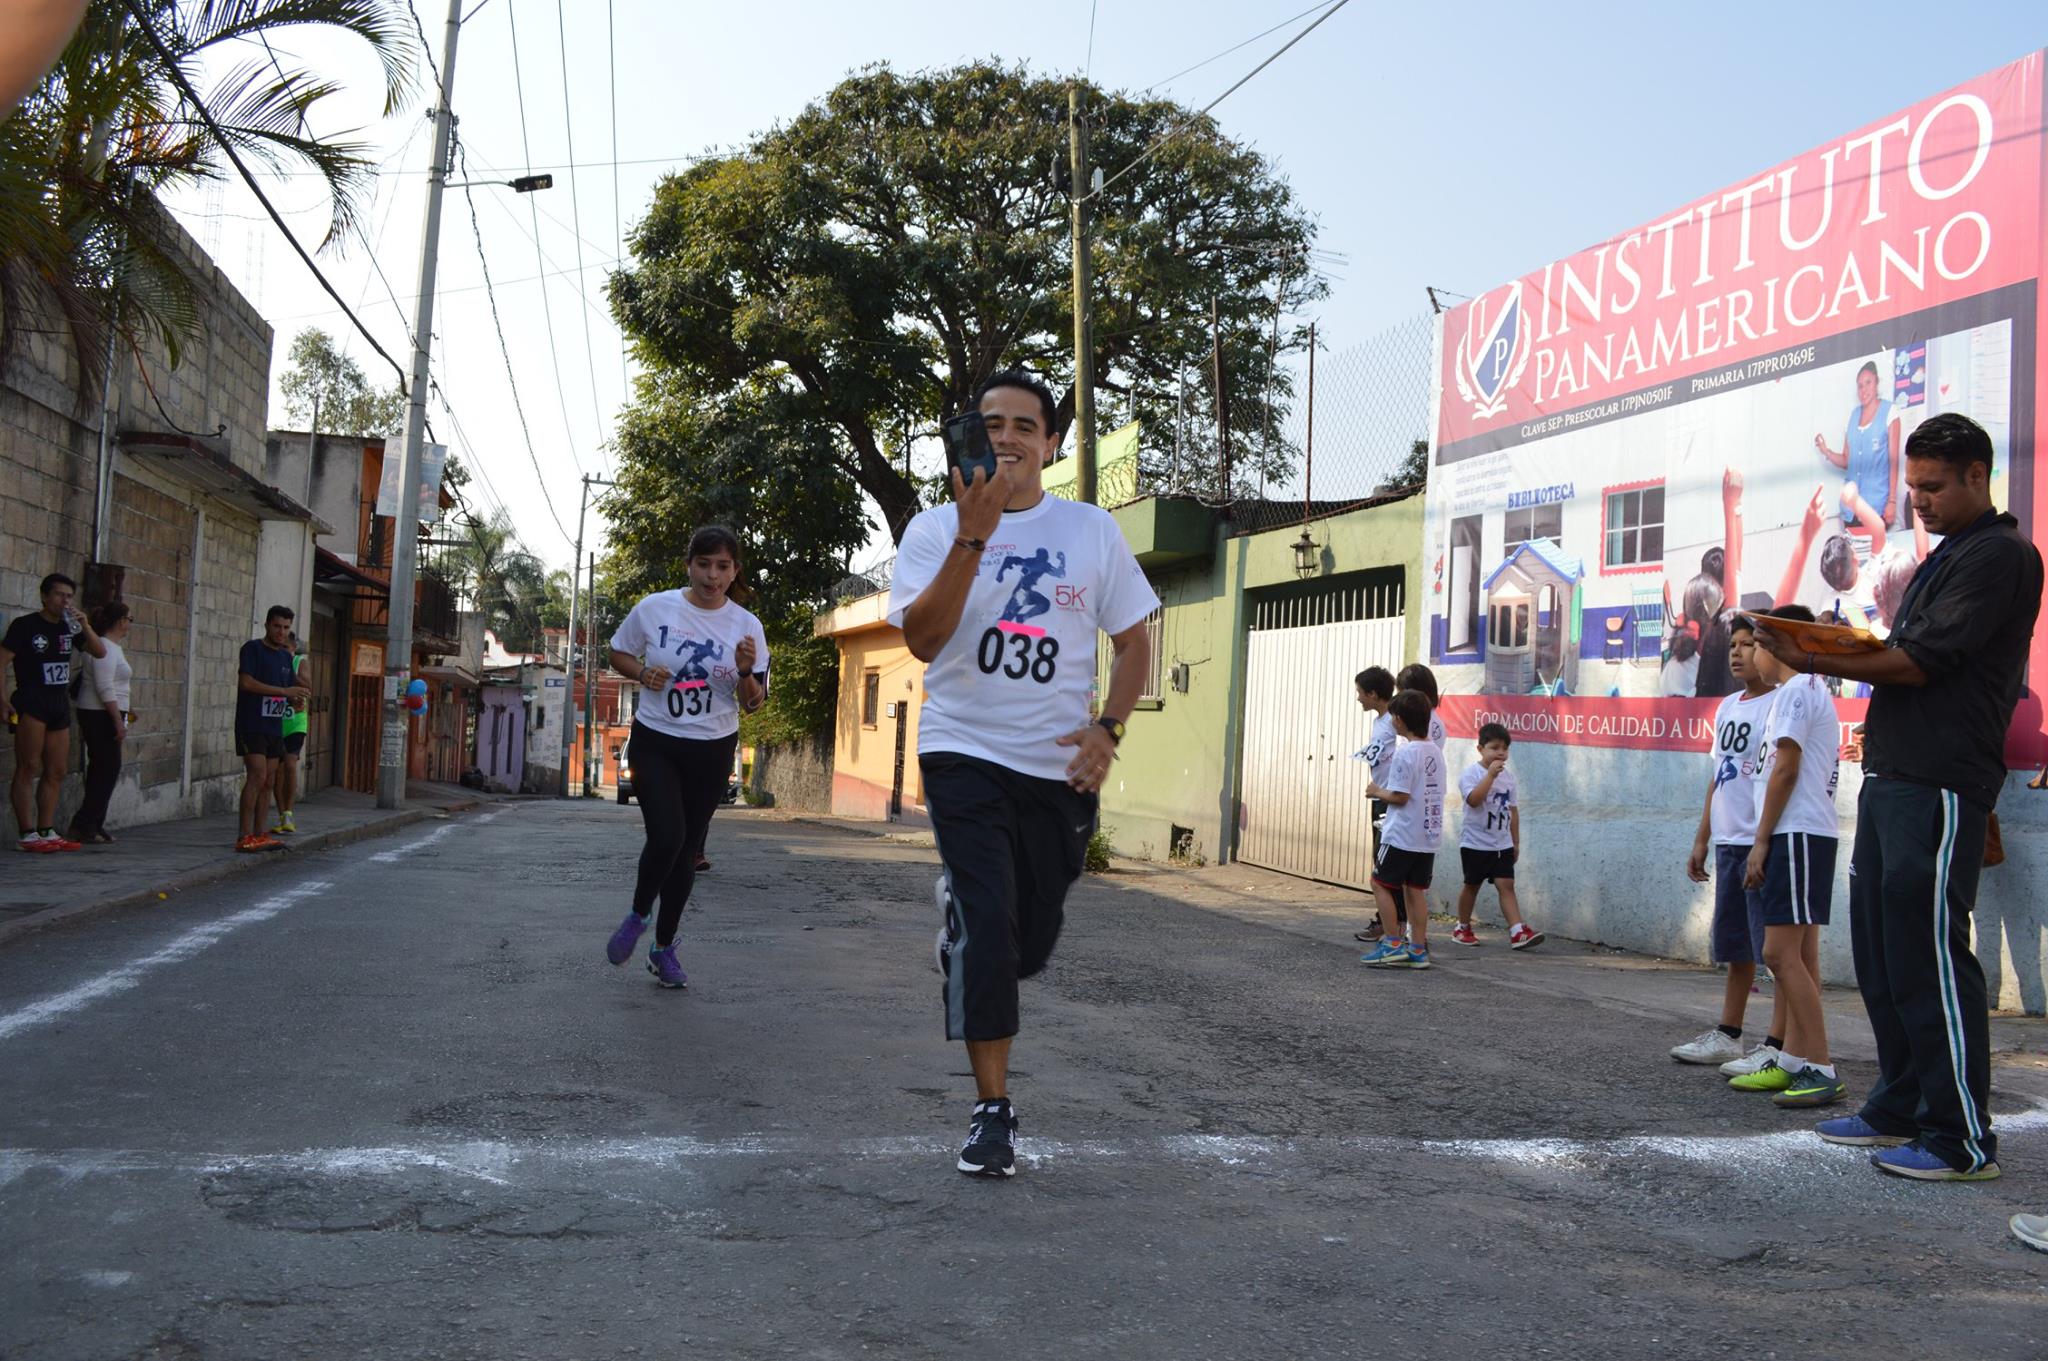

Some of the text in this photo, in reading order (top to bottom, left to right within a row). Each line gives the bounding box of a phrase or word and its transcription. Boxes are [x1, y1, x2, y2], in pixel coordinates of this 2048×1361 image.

[1536, 93, 1994, 342] INSTITUTO
[1533, 211, 1991, 404] PANAMERICANO
[1492, 337, 1508, 381] P
[1691, 346, 1815, 393] PRIMARIA 17PPR0369E
[1521, 422, 1546, 438] CLAVE
[1565, 403, 1619, 428] PREESCOLAR
[1508, 482, 1575, 509] BIBLIOTECA
[1055, 585, 1088, 608] 5K
[712, 665, 737, 680] 5K
[977, 626, 1060, 684] 038
[667, 685, 713, 718] 037
[1473, 709, 1560, 733] FORMACIÓN
[1564, 714, 1584, 734] DE
[1588, 715, 1666, 738] CALIDAD
[1669, 718, 1683, 738] A
